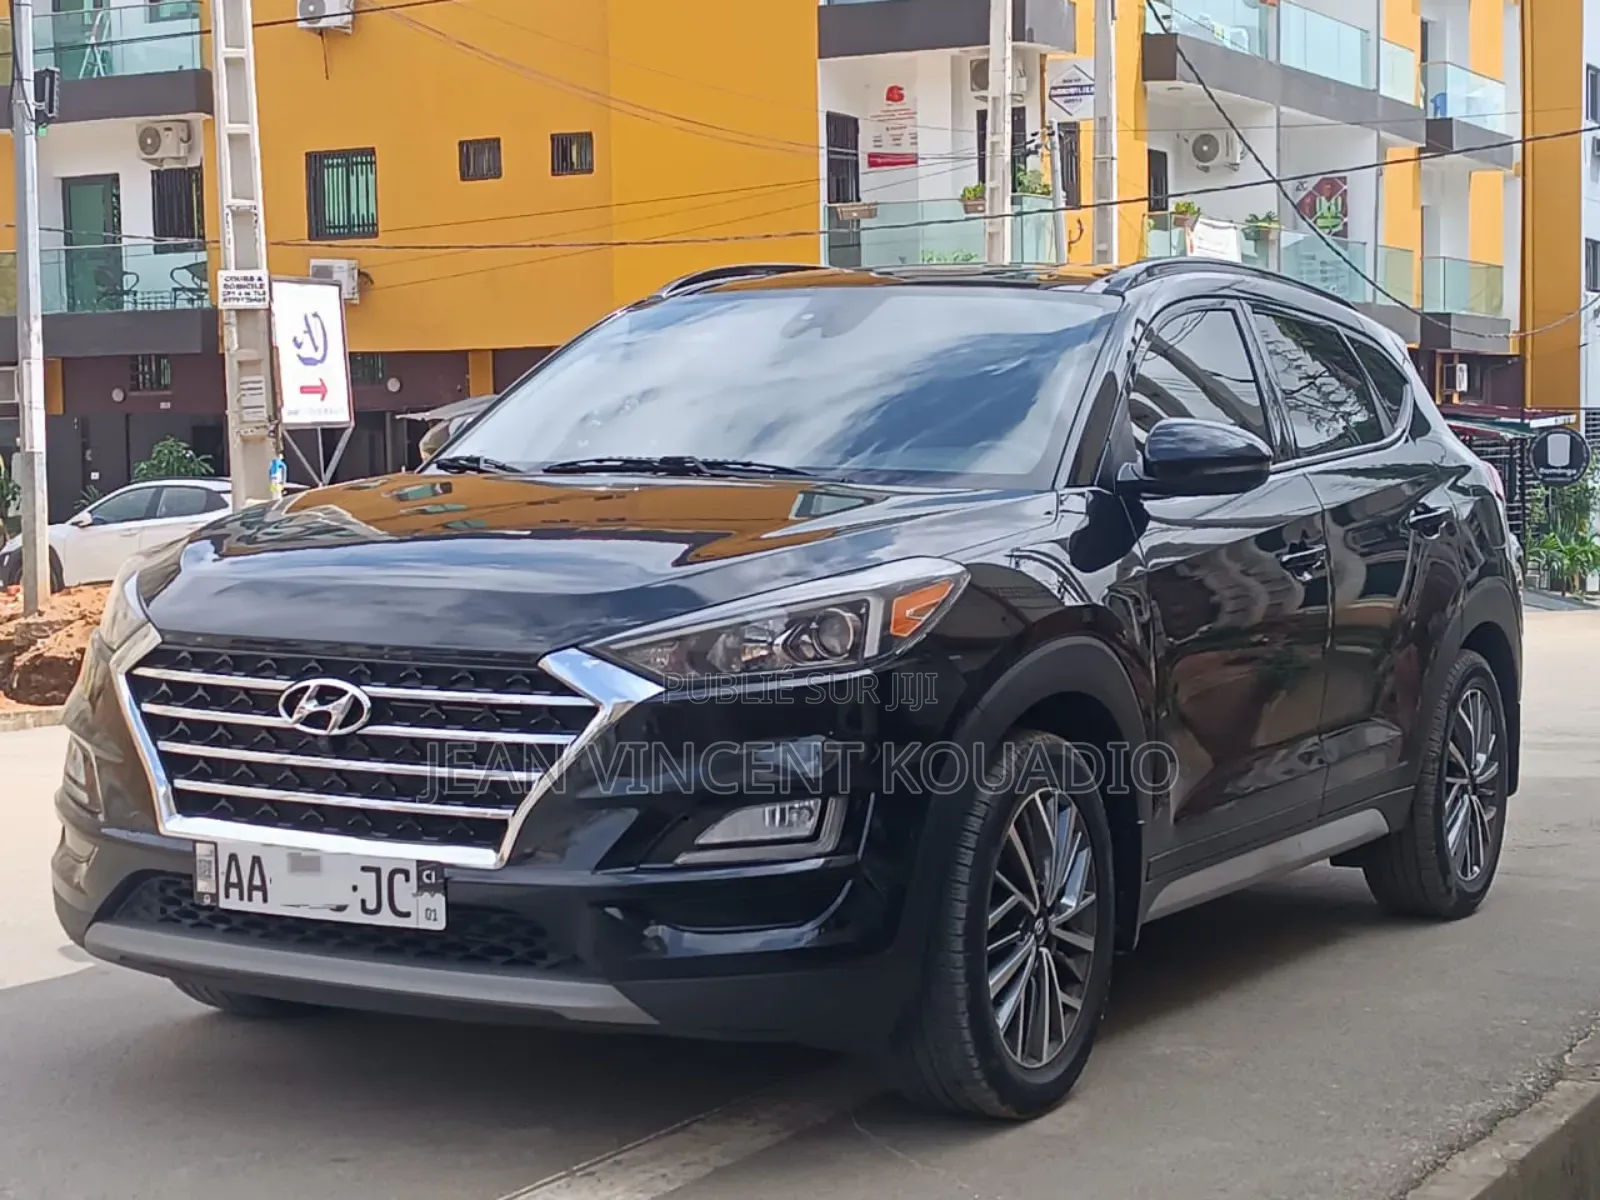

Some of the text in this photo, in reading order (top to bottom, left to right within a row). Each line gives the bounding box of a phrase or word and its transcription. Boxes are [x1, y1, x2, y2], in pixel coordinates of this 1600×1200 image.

[224, 852, 412, 918] AA JC
[425, 907, 438, 922] 01
